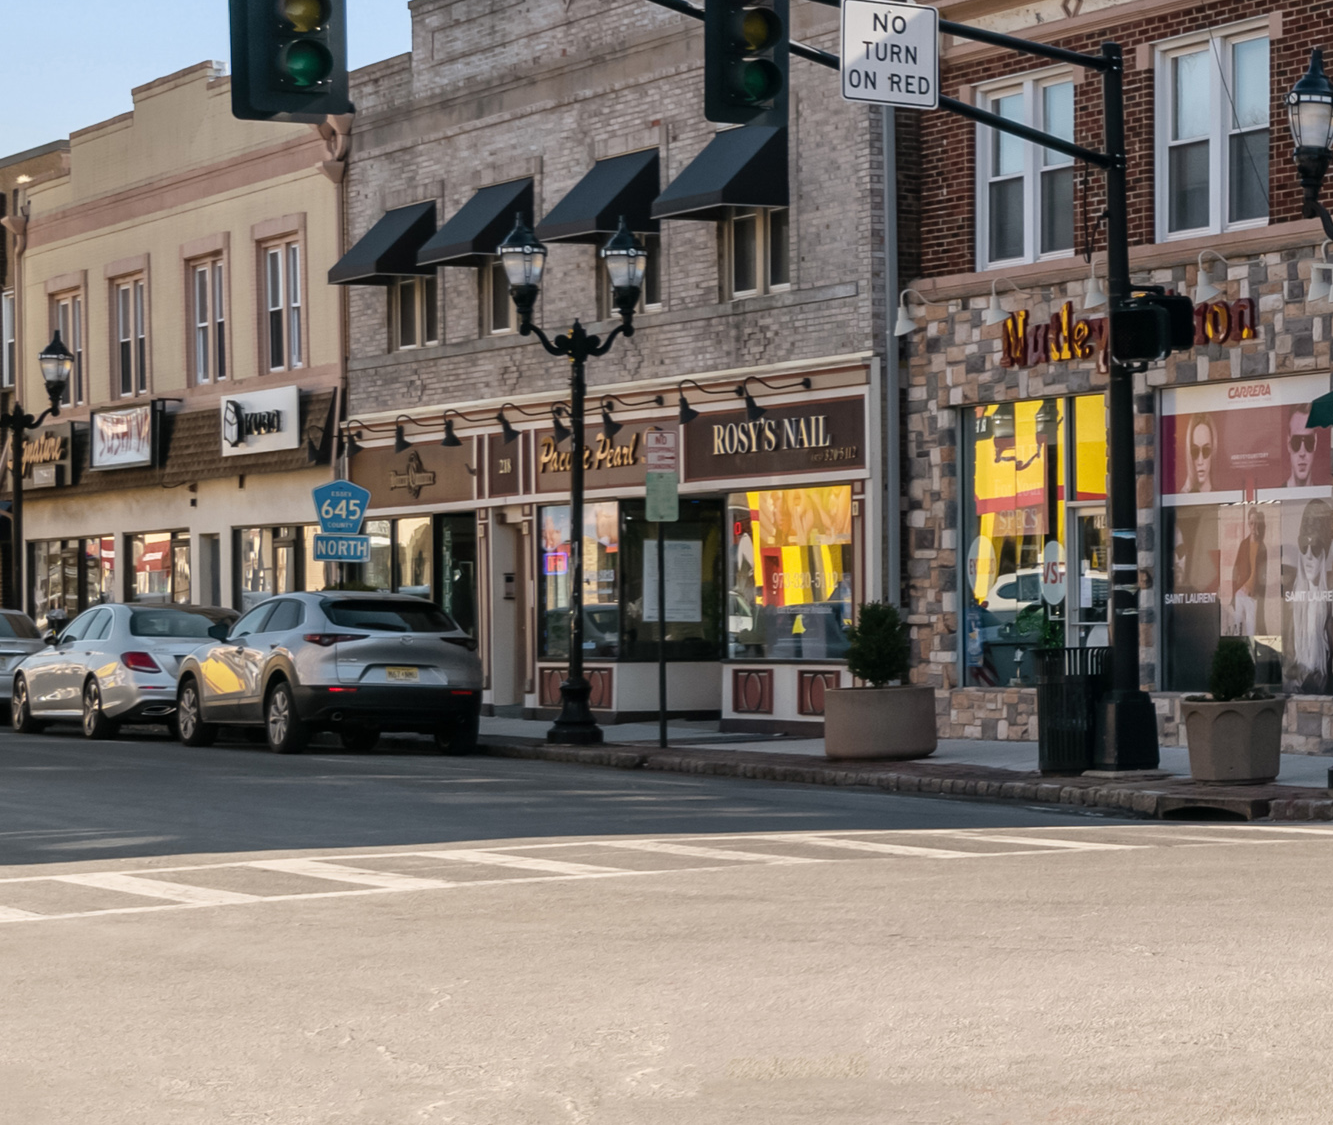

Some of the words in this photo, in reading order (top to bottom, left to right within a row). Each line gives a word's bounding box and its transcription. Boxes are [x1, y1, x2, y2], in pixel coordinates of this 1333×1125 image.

[873, 12, 907, 35] NO
[862, 40, 918, 65] TURN
[849, 69, 877, 91] ON
[890, 73, 930, 95] RED
[1227, 383, 1272, 400] CARRERA
[712, 417, 776, 455] ROSY'S
[781, 415, 832, 450] NAIL
[539, 436, 593, 473] Pacic
[595, 432, 638, 469] Pearl
[321, 499, 361, 520] 645
[999, 508, 1038, 530] SPECS
[327, 521, 353, 529] COUNTY
[317, 539, 367, 556] NORTH
[1164, 594, 1184, 605] SAINT
[1185, 592, 1218, 604] LAURENT
[1285, 590, 1307, 603] SAINT
